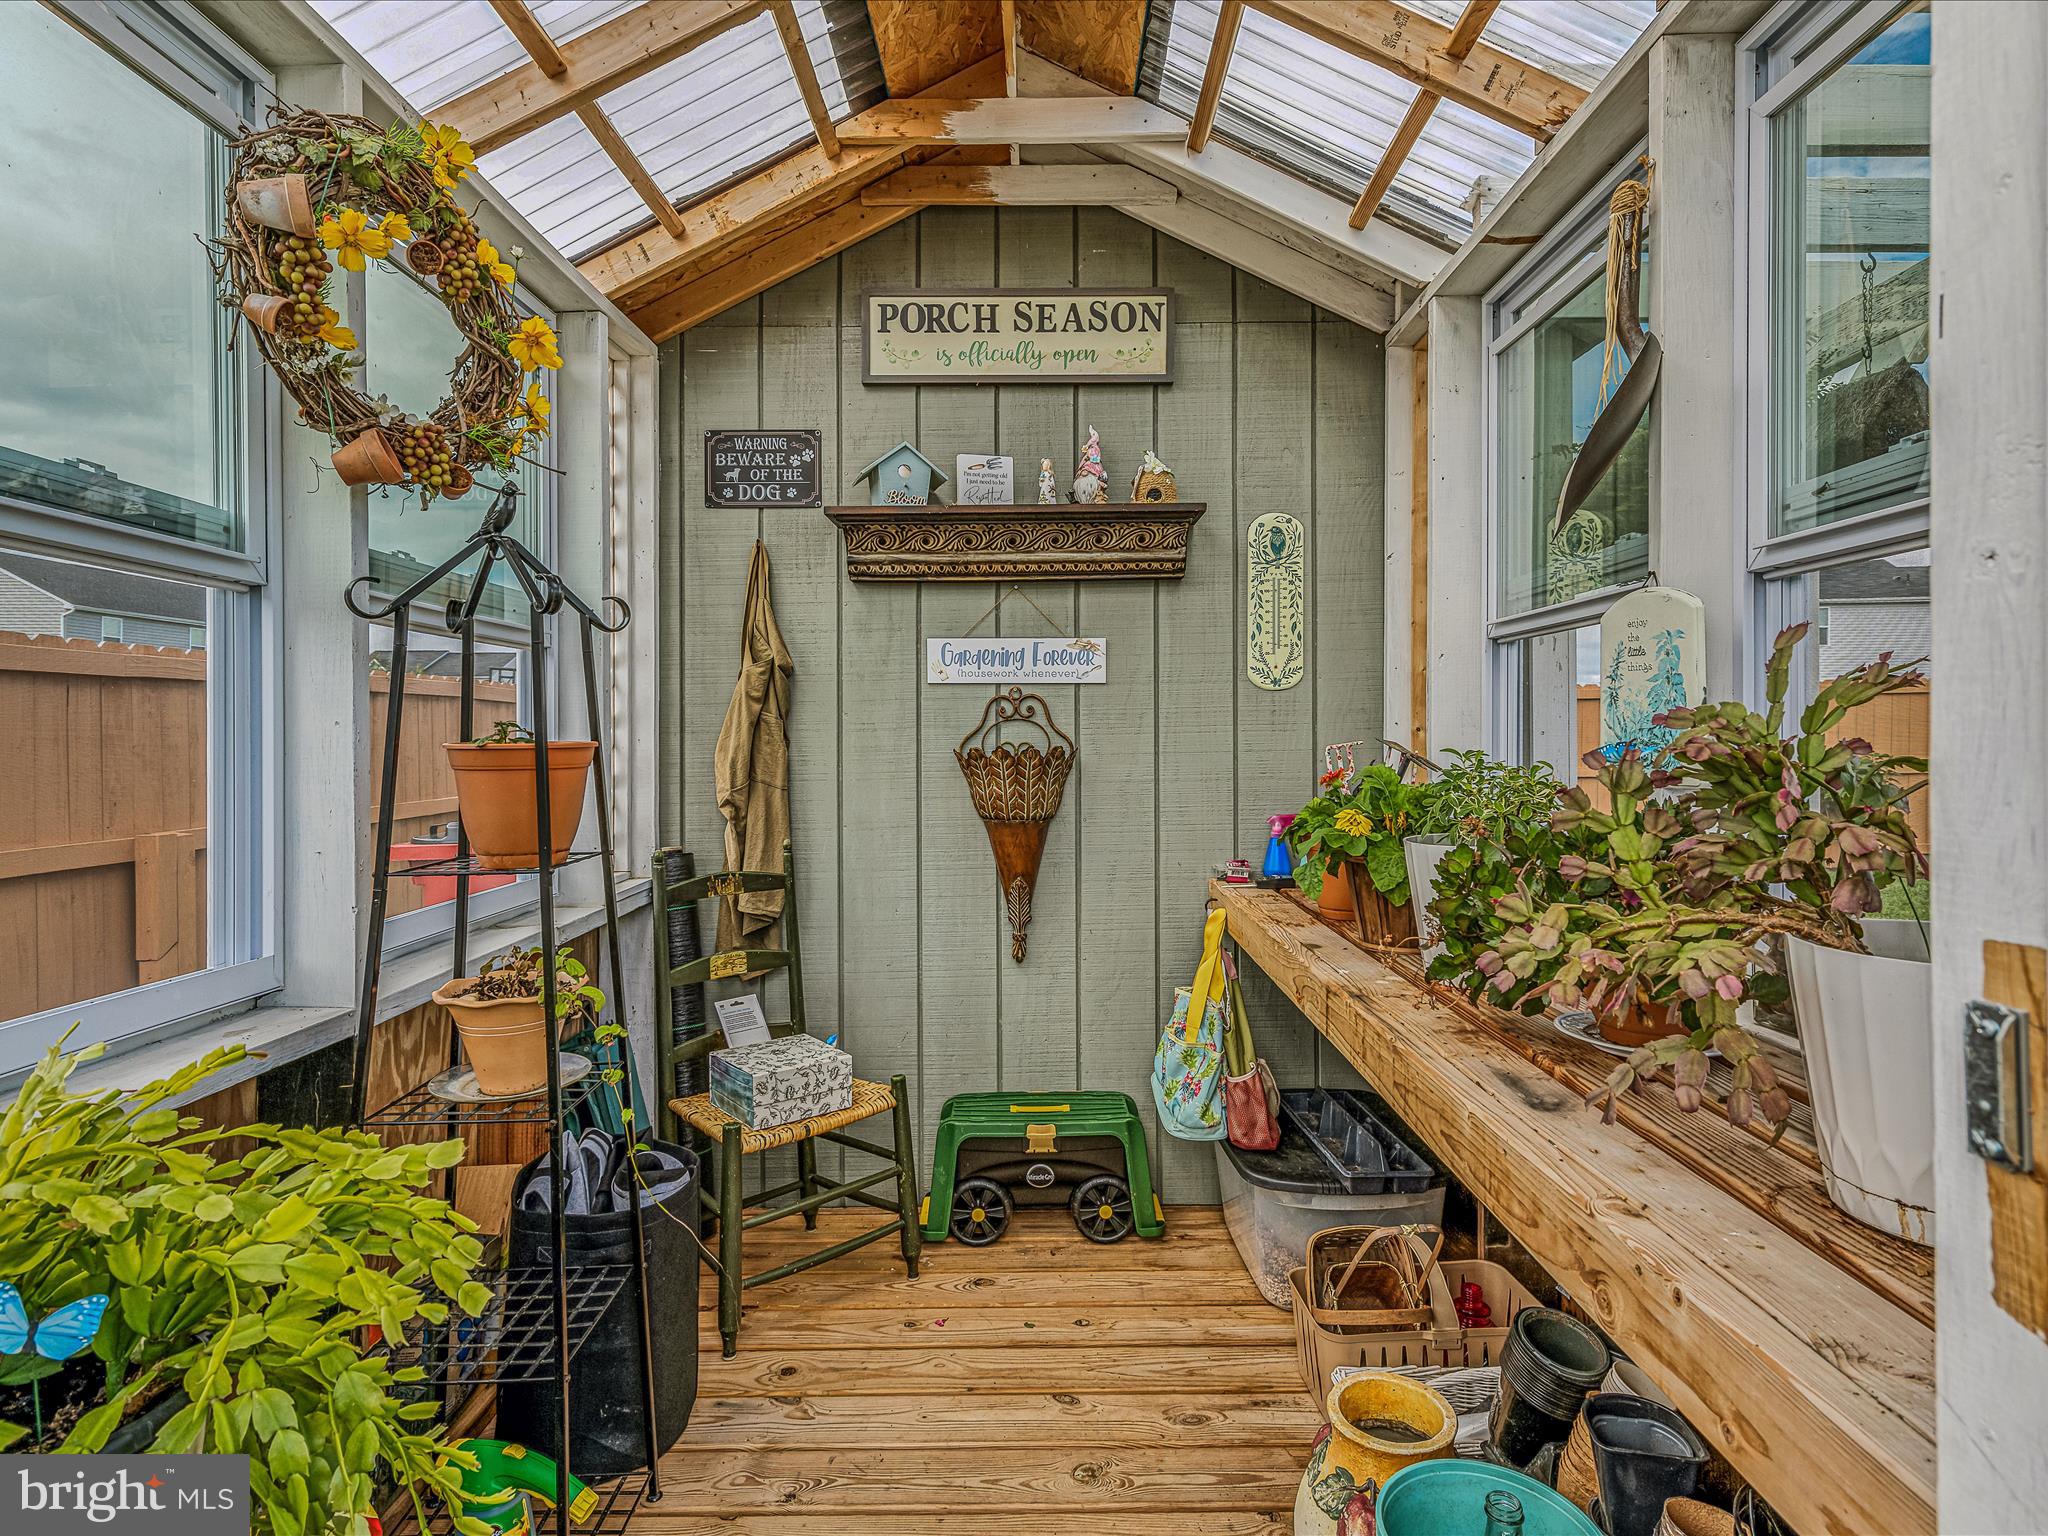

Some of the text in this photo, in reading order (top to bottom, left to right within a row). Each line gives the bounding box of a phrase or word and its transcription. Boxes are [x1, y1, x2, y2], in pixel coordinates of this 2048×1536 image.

[877, 300, 1165, 333] PORCH SEASON
[936, 340, 1099, 370] is officially open
[734, 435, 788, 450] WARNING
[715, 451, 787, 466] BEWARE
[750, 468, 803, 481] OF THE
[738, 484, 782, 501] DOG
[886, 489, 927, 505] Bloom
[1627, 618, 1648, 629] enjoy
[1627, 632, 1640, 642] the
[1627, 646, 1646, 657] little
[1627, 661, 1653, 673] things
